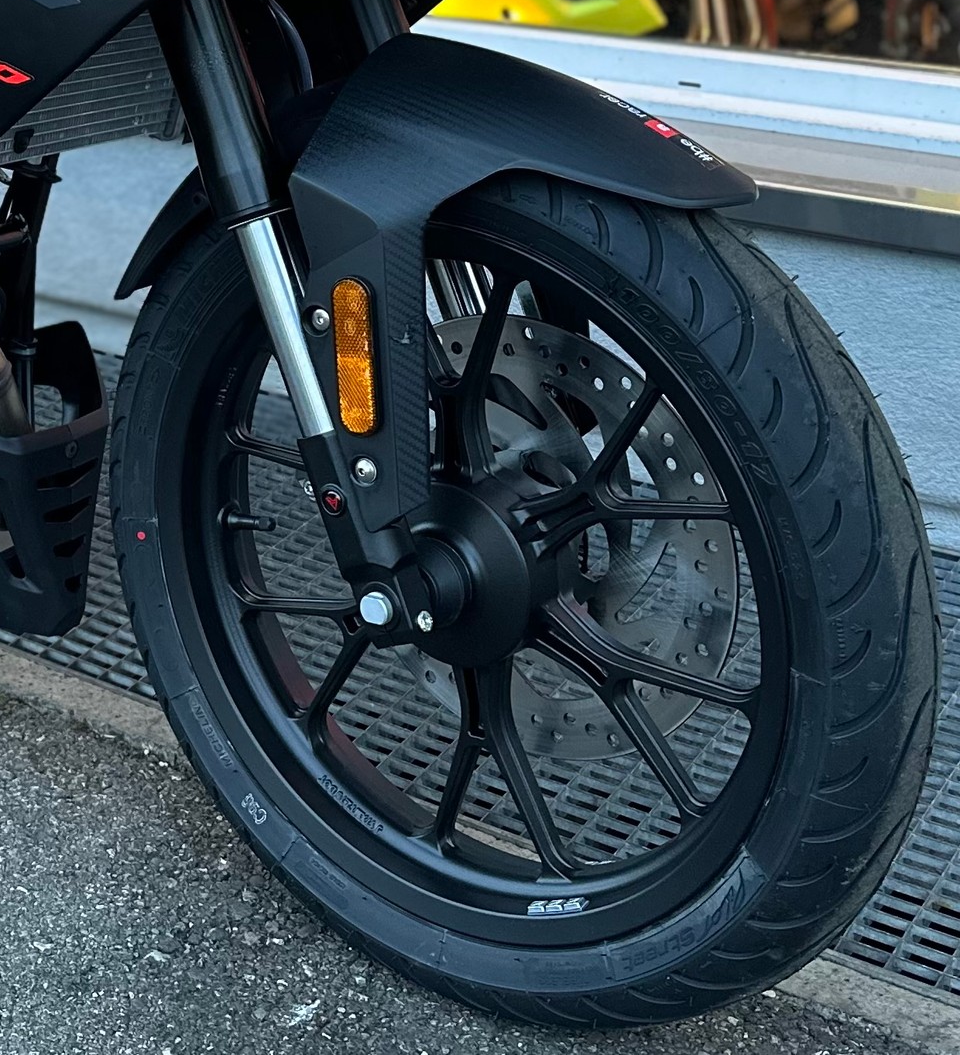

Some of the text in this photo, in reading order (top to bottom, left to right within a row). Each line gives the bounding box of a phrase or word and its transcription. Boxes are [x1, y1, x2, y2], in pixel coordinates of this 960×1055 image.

[599, 92, 647, 118] racer
[680, 138, 714, 162] #be
[619, 286, 778, 486] 100/80-17
[193, 705, 233, 768] MICHELIN
[621, 926, 696, 972] Street
